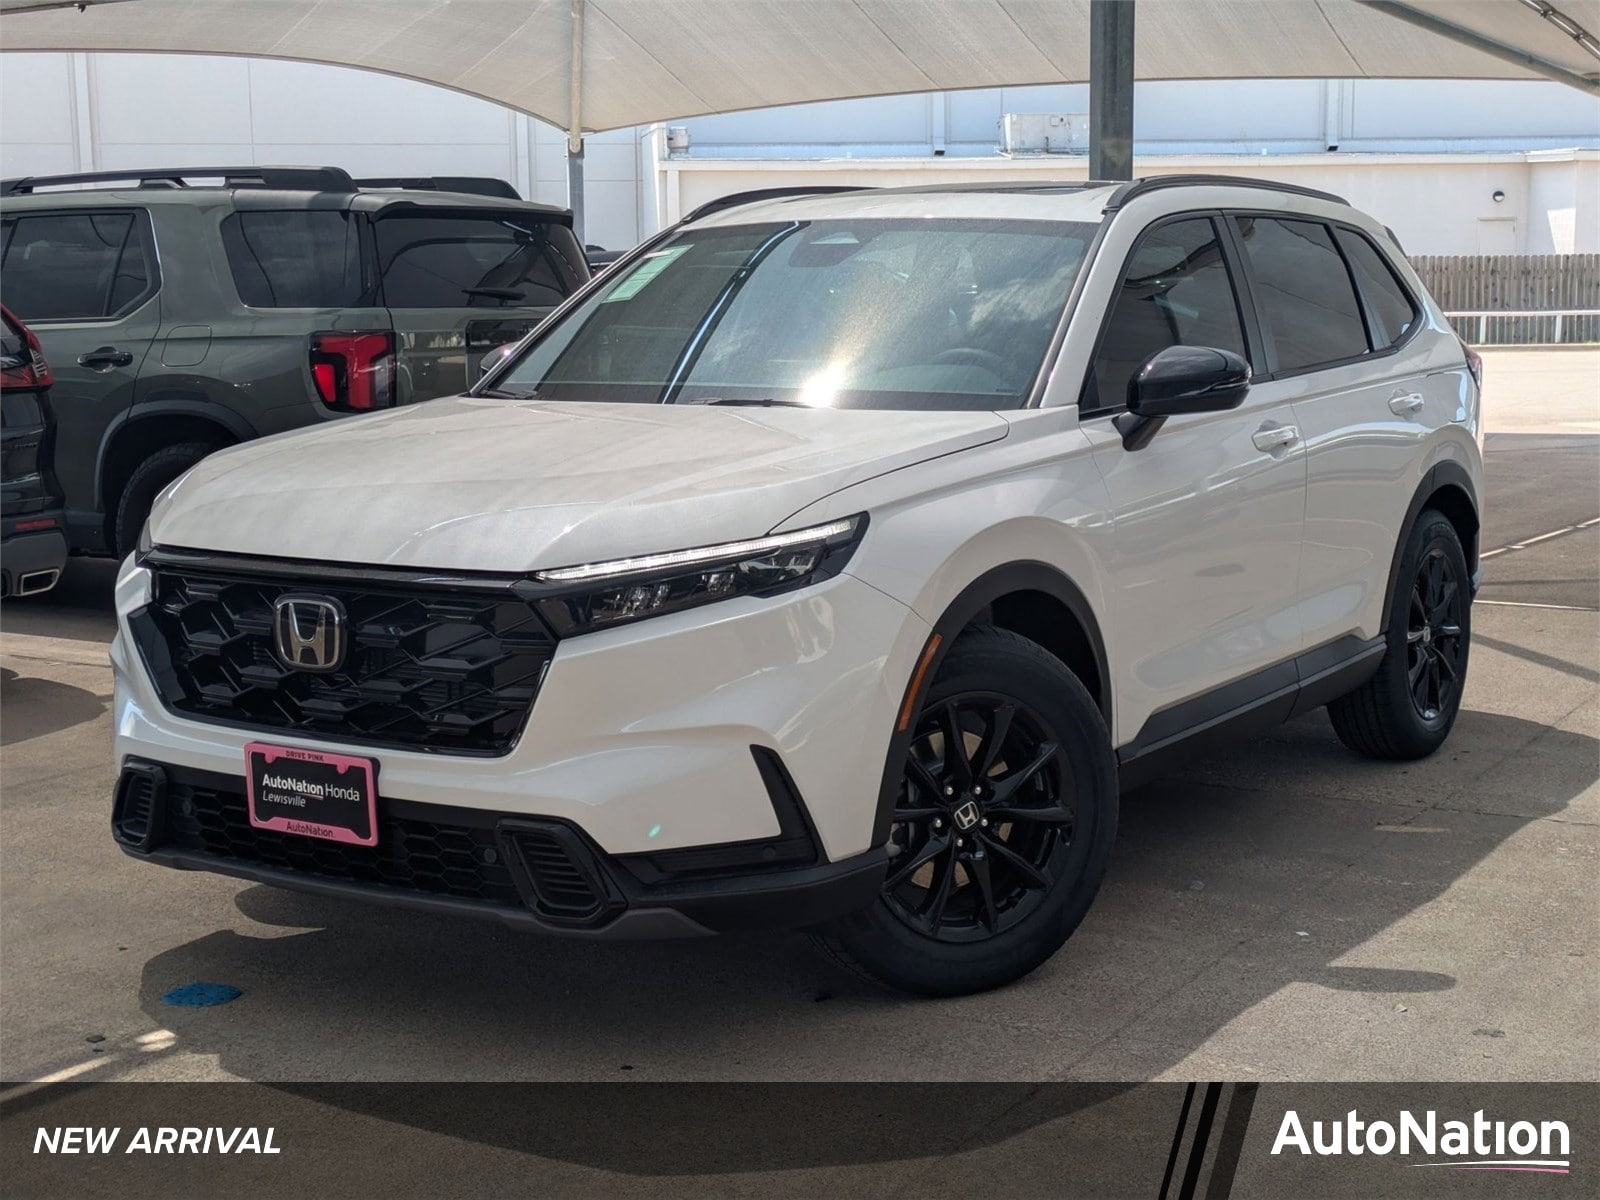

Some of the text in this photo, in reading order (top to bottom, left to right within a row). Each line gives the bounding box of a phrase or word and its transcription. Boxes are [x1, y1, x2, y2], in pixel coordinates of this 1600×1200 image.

[285, 750, 324, 762] DRIVE PINK
[262, 773, 360, 802] AutoNation Honda
[262, 790, 306, 807] Lewisville
[286, 821, 334, 837] AutoNation
